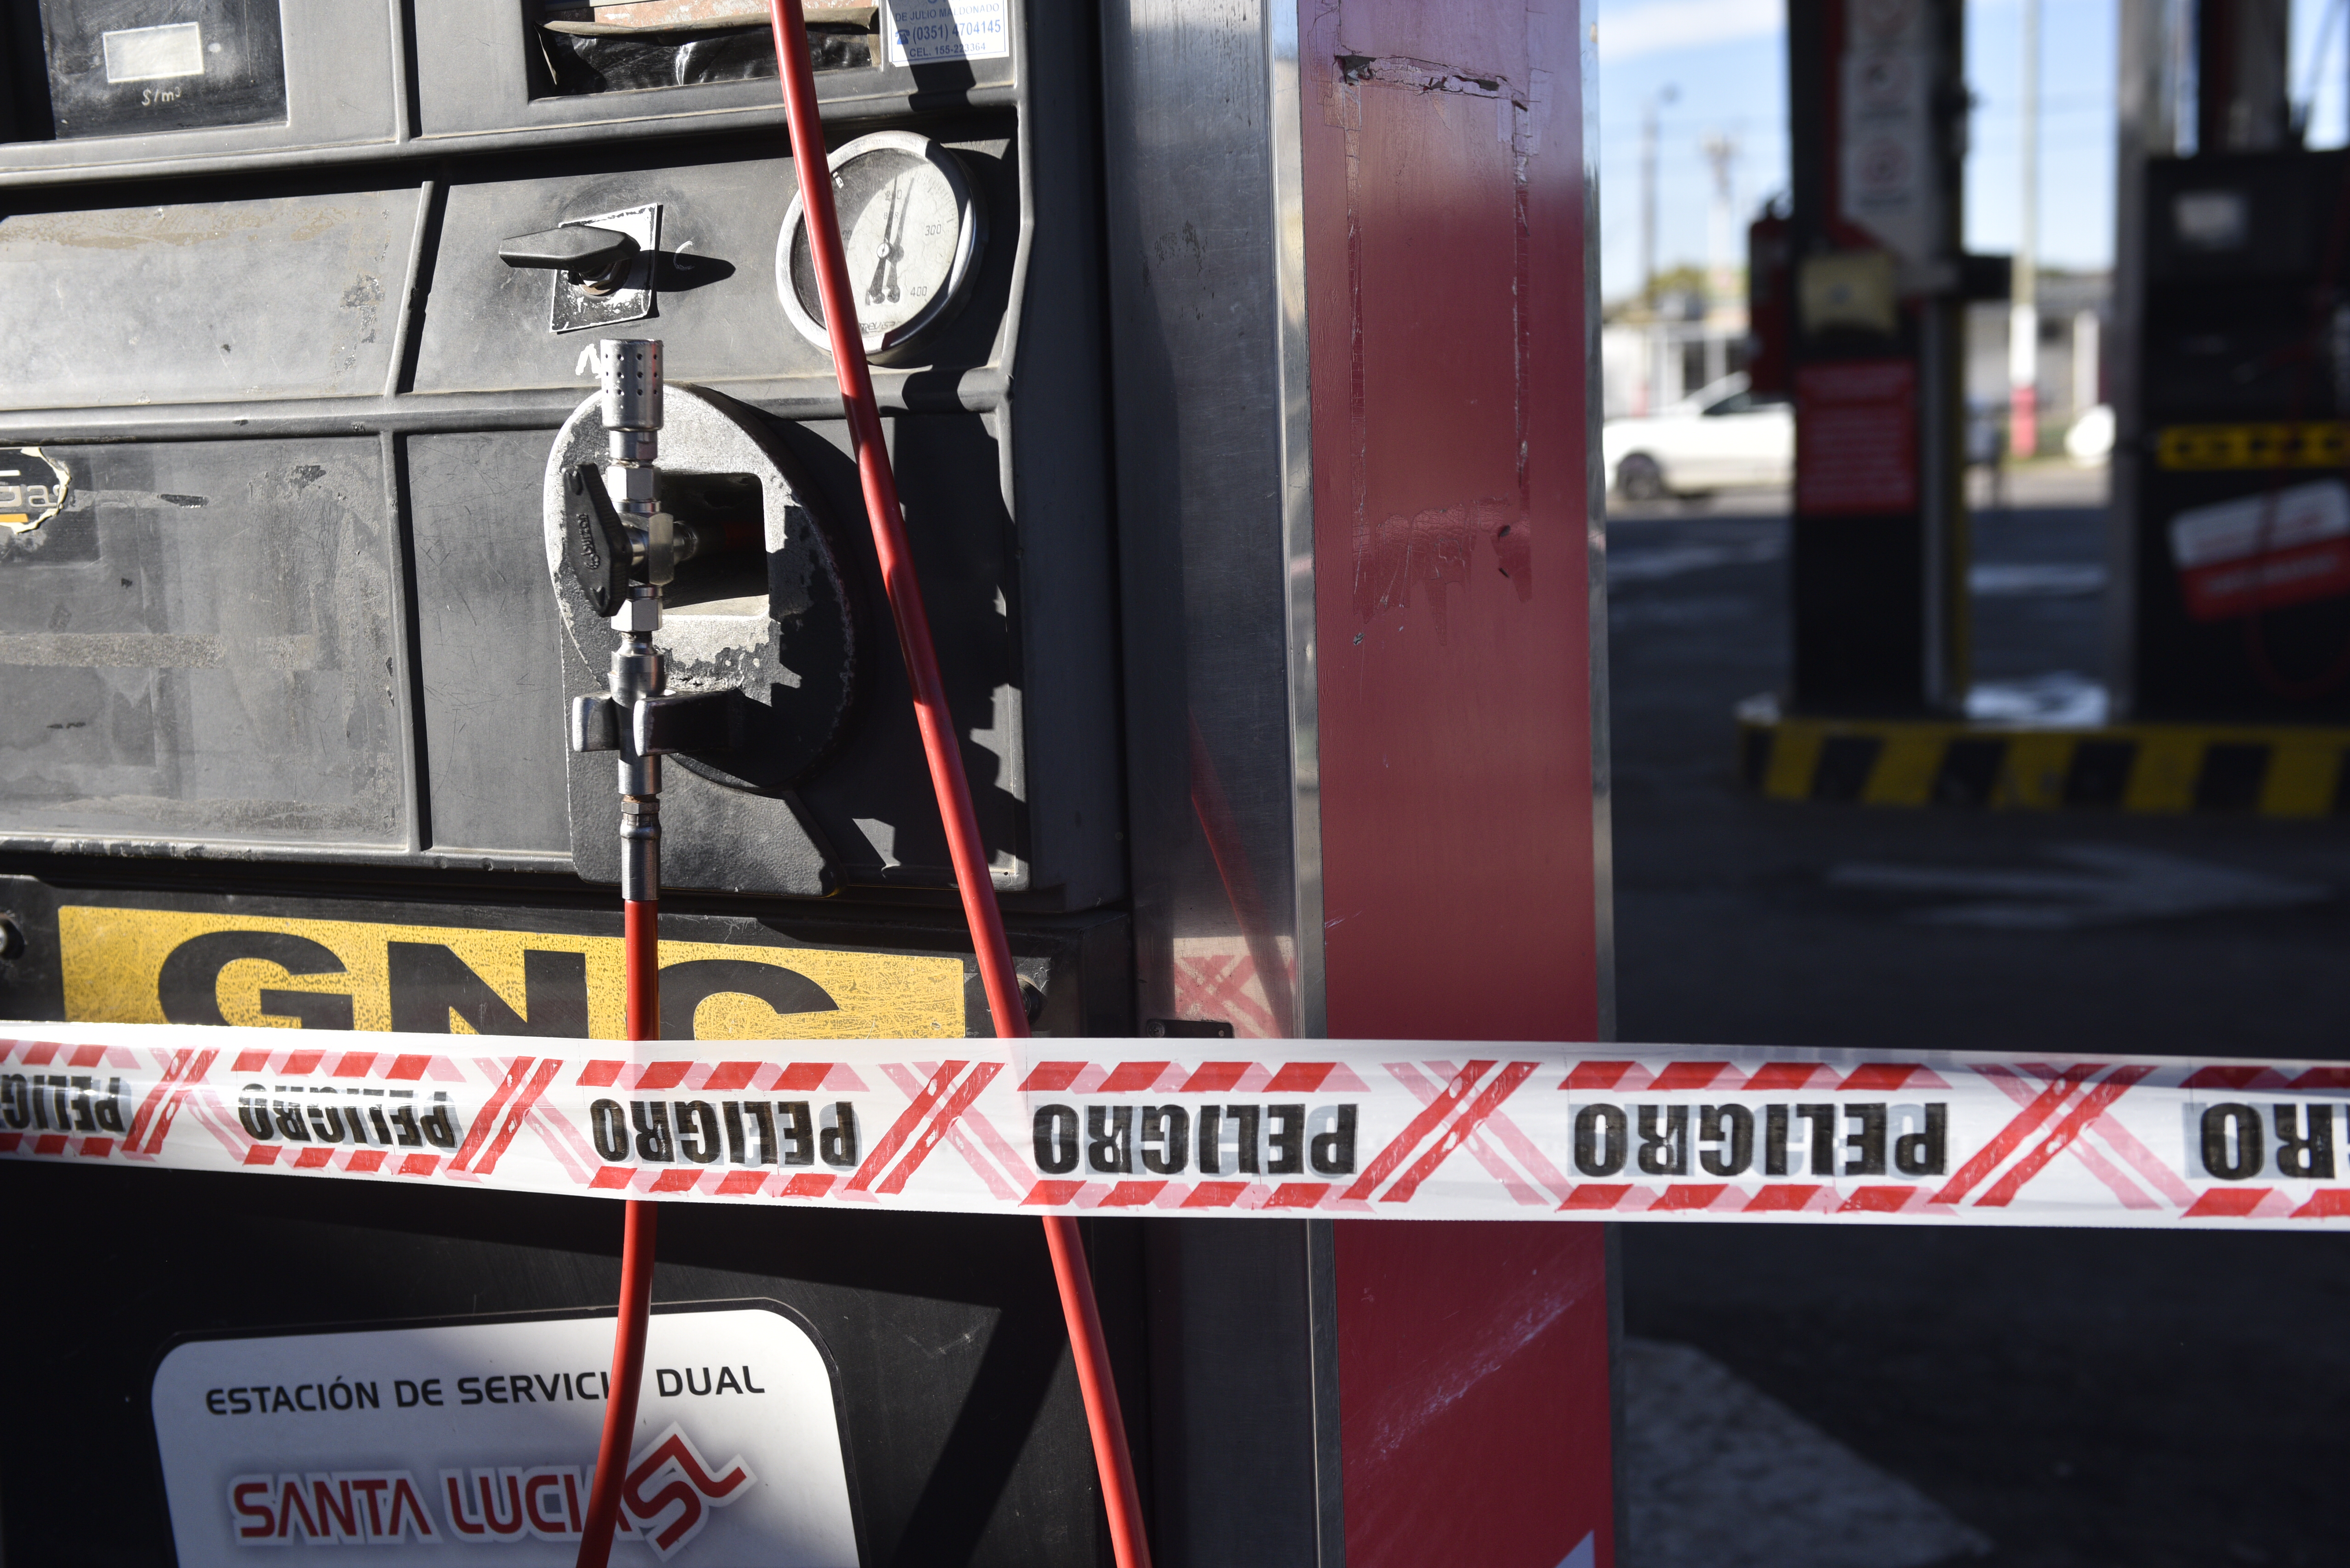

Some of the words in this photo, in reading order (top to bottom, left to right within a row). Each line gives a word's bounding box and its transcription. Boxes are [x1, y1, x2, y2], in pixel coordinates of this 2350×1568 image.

[895, 12, 907, 22] DE
[910, 9, 937, 20] JULIO
[939, 3, 1000, 17] MALDONADO
[912, 24, 949, 45] (0351)
[952, 19, 1001, 37] 4704145
[910, 48, 932, 57] CEL.
[934, 42, 986, 55] 155-223364
[884, 189, 902, 202] 20
[884, 212, 899, 220] BR
[925, 224, 941, 236] 300
[910, 286, 927, 297] 400
[157, 930, 840, 1040] GNC
[238, 1083, 458, 1149] PELIGRO
[589, 1098, 857, 1166] PELIGRO
[1032, 1103, 1359, 1174] PELIGRO
[1574, 1102, 1947, 1177] PELIGRO
[2199, 1103, 2350, 1180] RO
[206, 1376, 380, 1416] ESTACIÓN
[394, 1378, 444, 1408] DE
[458, 1371, 611, 1405] SERVICI
[655, 1365, 765, 1398] DUAL
[233, 1478, 432, 1538] SANTA
[447, 1474, 632, 1534] LUCI
